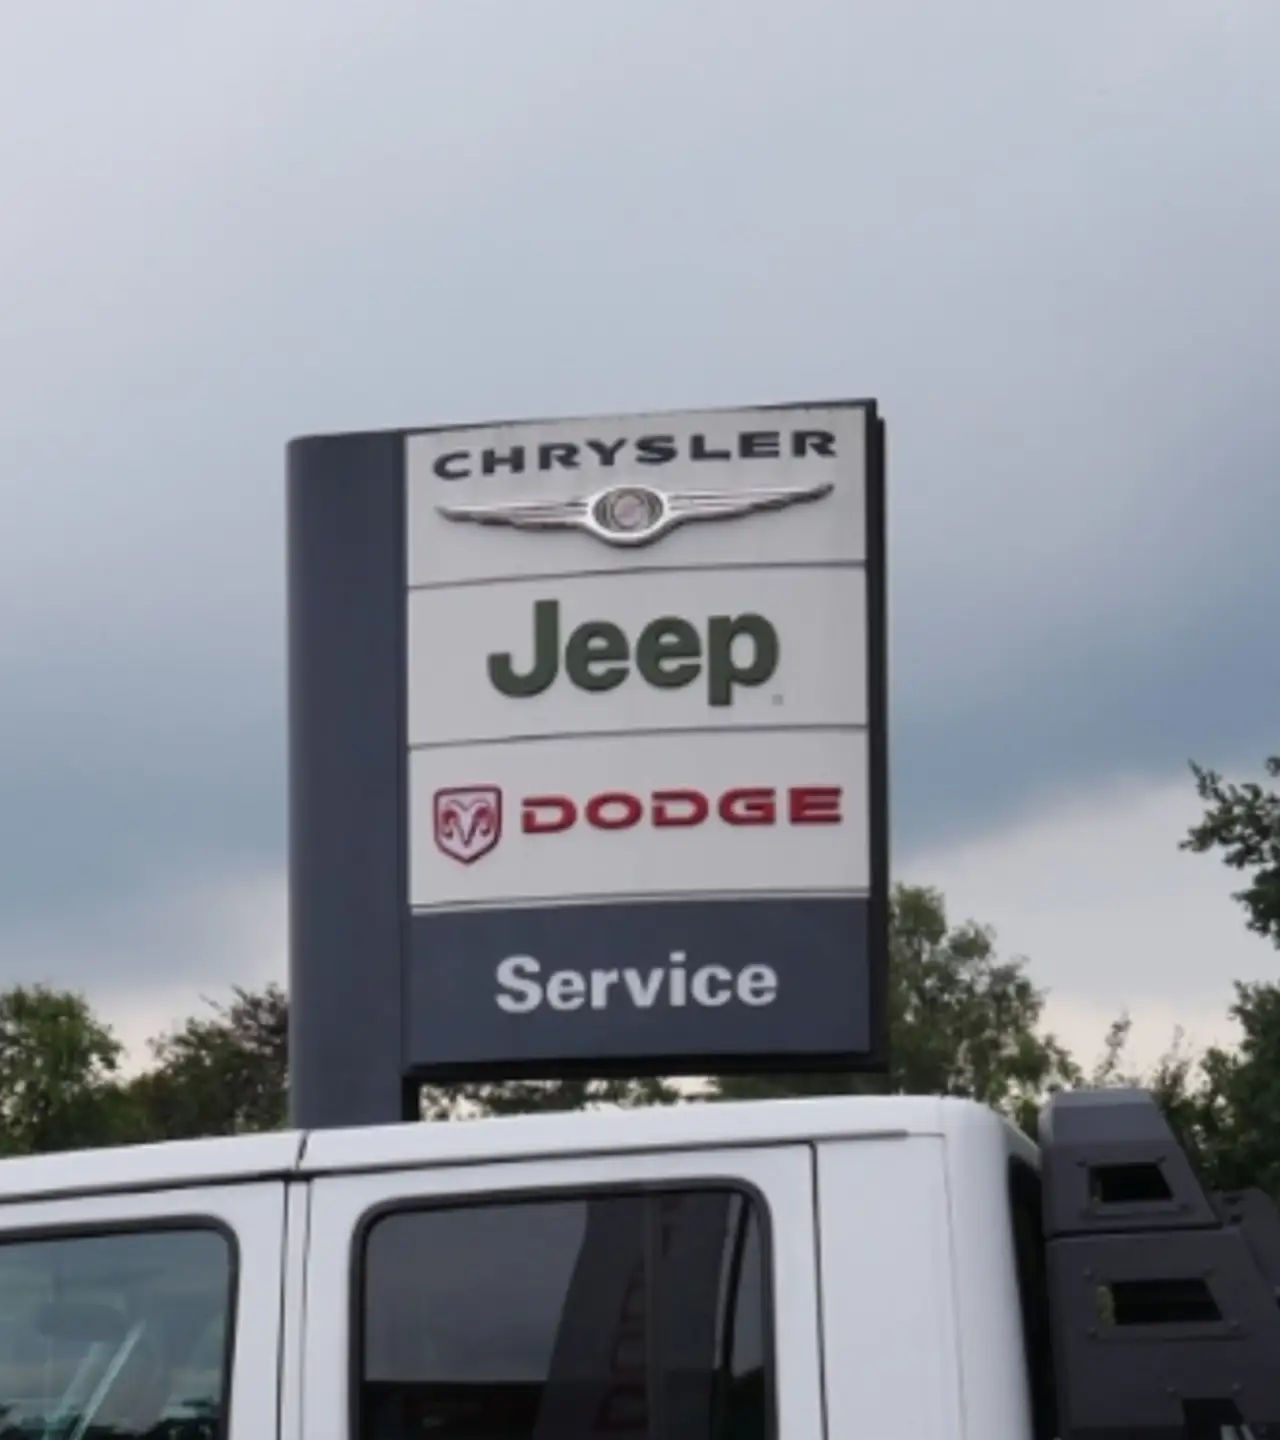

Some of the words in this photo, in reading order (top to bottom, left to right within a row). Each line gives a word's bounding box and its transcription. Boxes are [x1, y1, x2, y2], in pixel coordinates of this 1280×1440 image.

[433, 430, 837, 481] CHRYSLER
[487, 598, 780, 707] Jeep
[521, 787, 843, 835] DODGE
[494, 950, 779, 1013] Service
